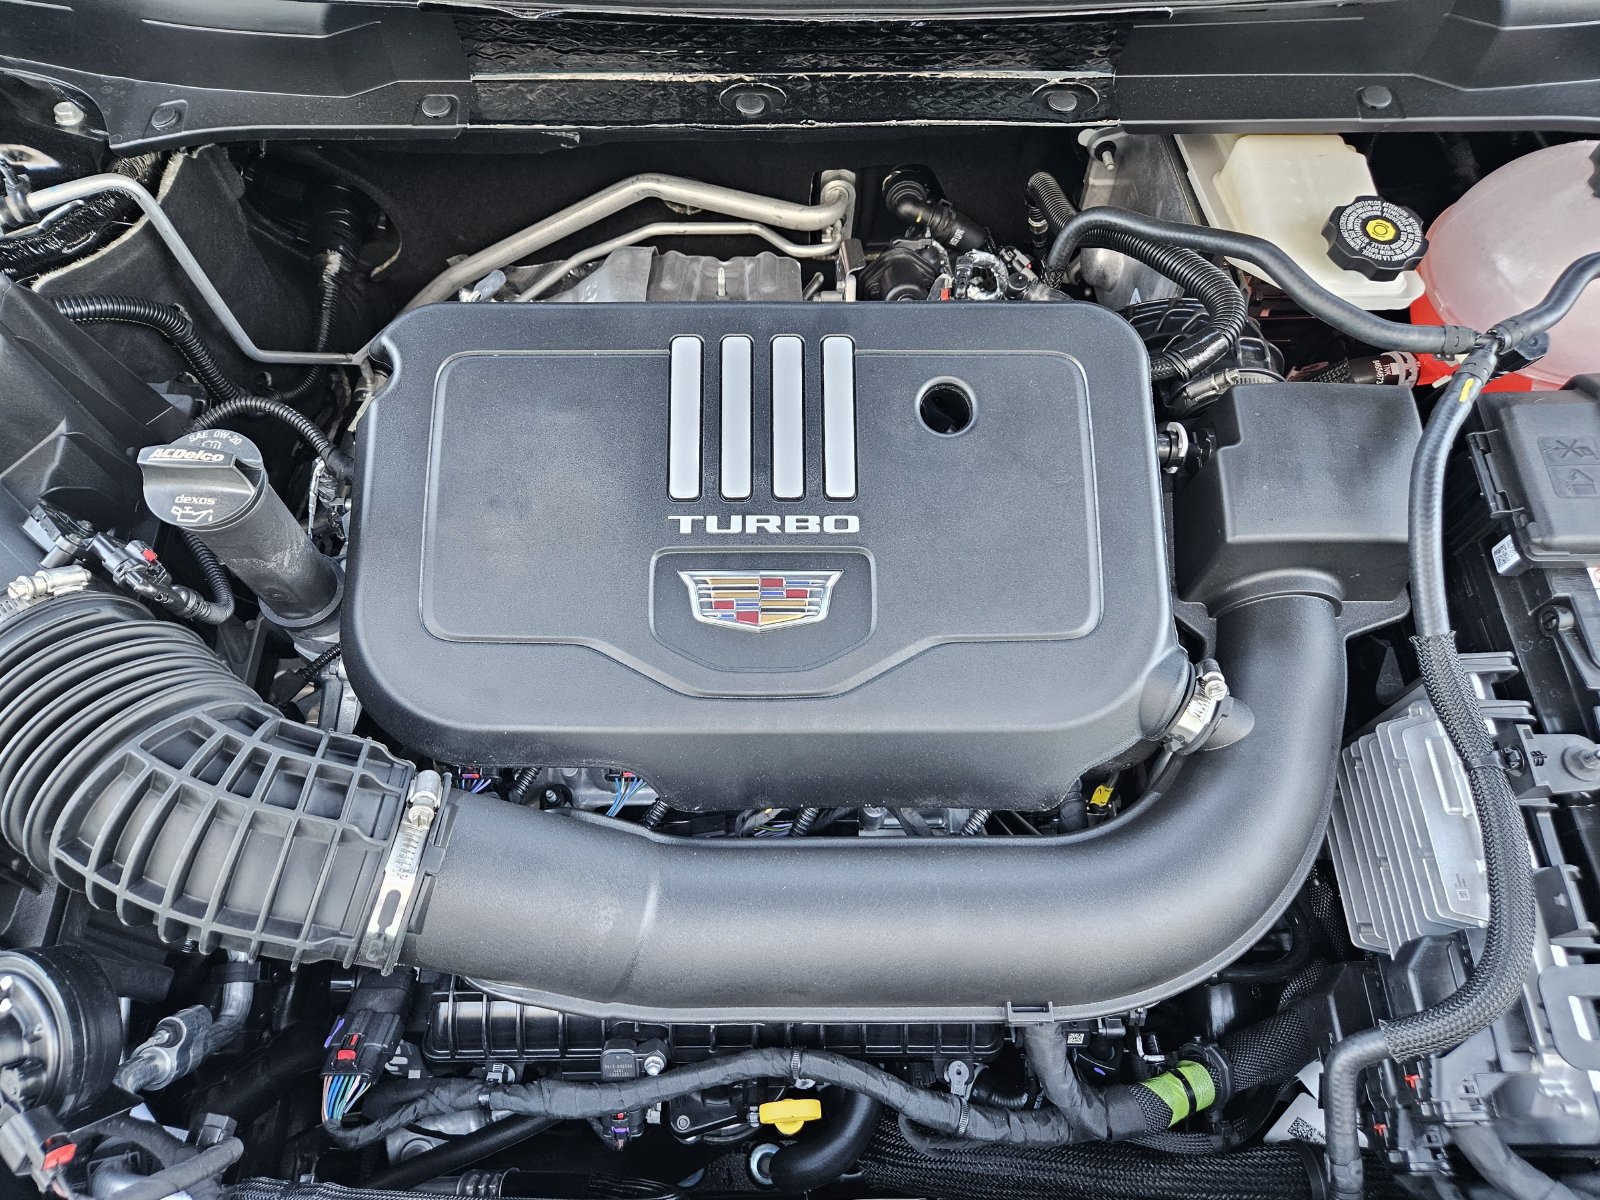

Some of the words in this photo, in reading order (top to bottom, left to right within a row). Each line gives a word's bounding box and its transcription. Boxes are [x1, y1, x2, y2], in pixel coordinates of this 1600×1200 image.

[189, 431, 208, 443] SAE
[213, 431, 242, 445] 0W-20
[149, 448, 225, 462] ACDelco
[175, 494, 216, 505] dexos
[668, 515, 860, 534] TURBO
